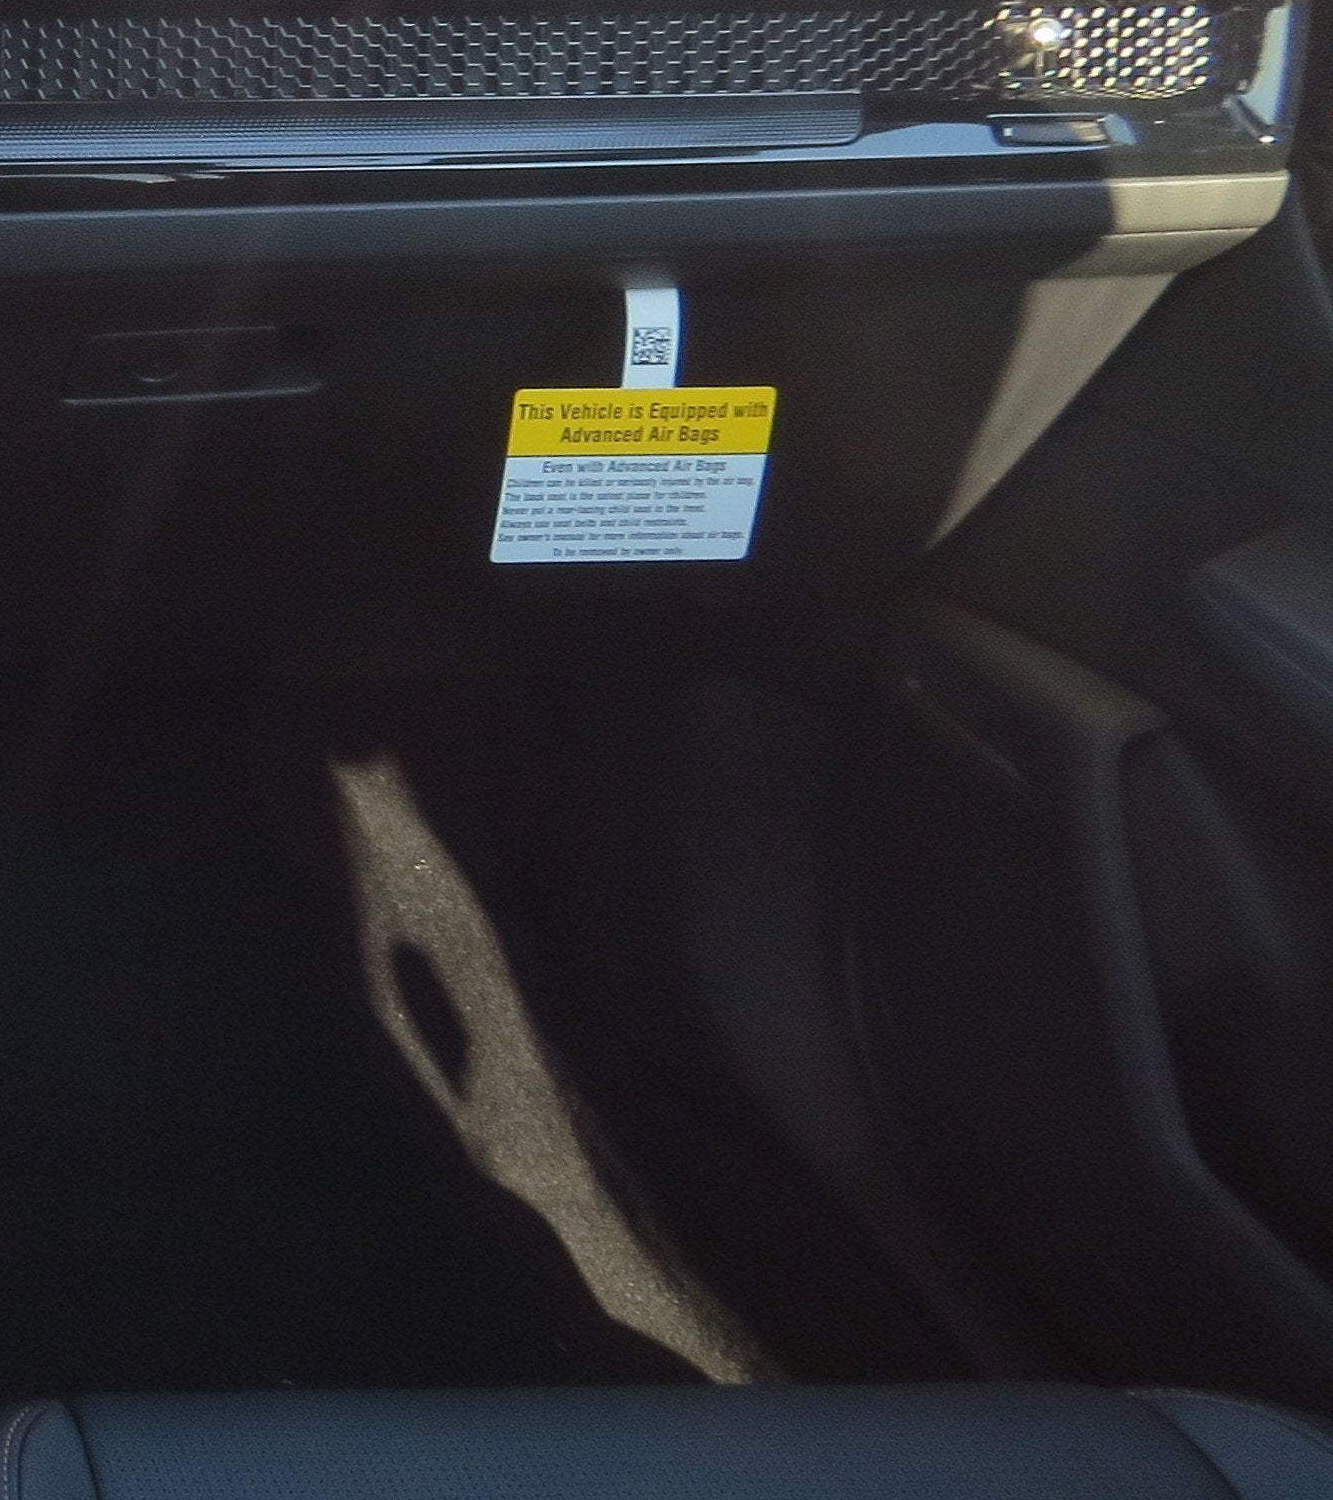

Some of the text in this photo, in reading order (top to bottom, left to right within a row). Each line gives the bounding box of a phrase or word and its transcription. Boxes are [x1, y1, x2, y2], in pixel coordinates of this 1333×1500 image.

[519, 401, 769, 423] This Vehicle is Equipped with
[559, 425, 720, 445] Advanced Air Bags
[542, 461, 573, 473] Even
[576, 461, 604, 473] with
[674, 460, 691, 471] Air
[696, 459, 727, 474] Bags
